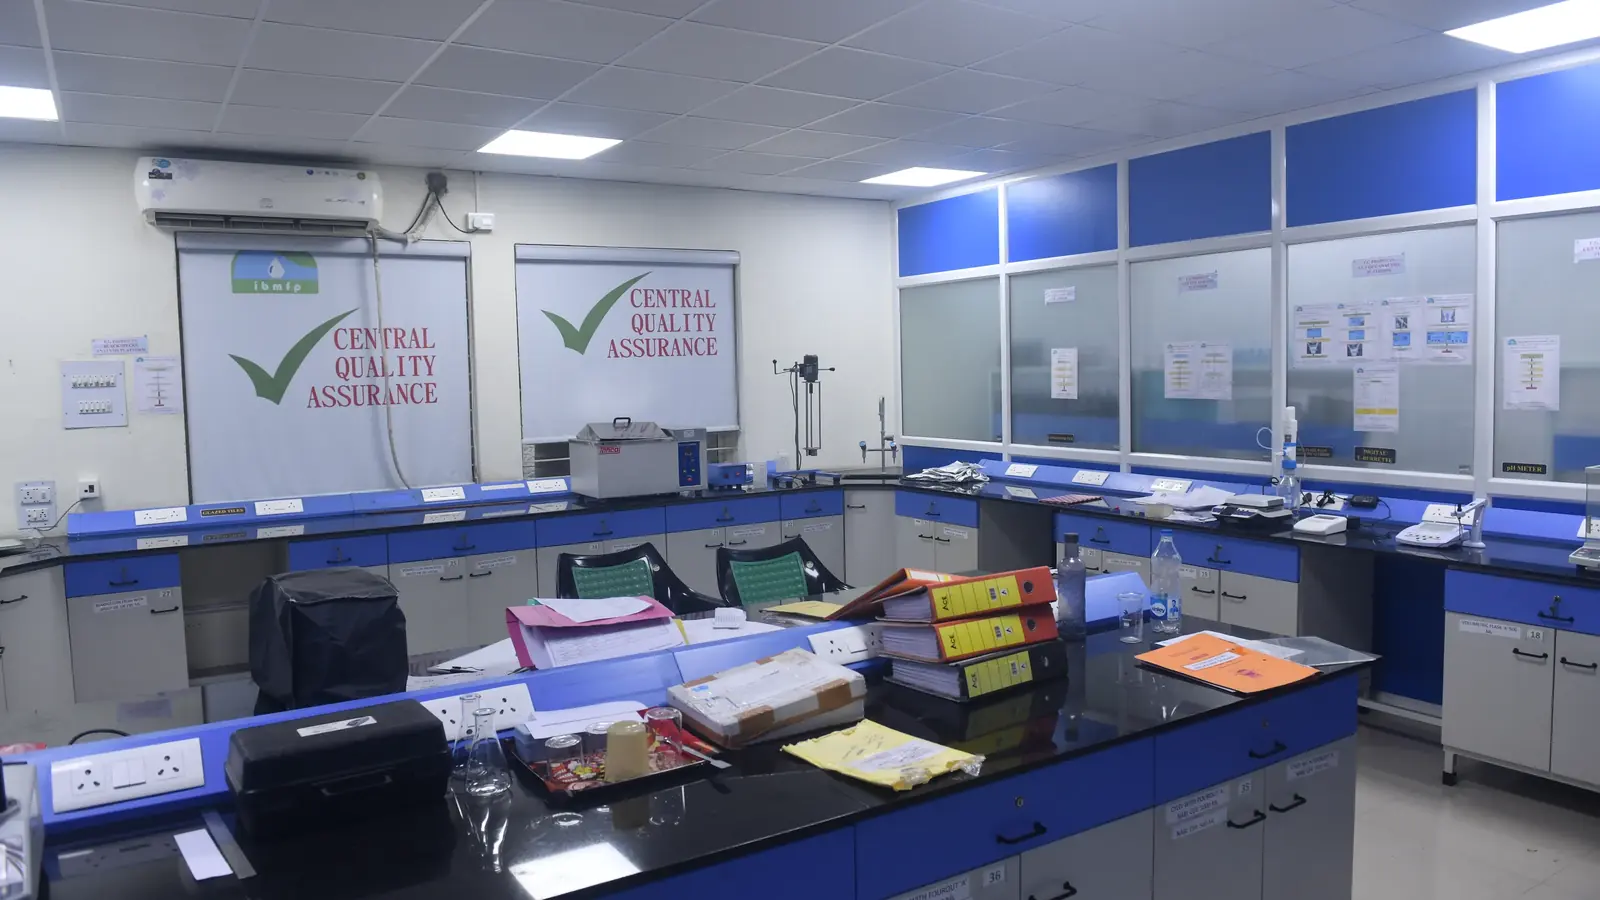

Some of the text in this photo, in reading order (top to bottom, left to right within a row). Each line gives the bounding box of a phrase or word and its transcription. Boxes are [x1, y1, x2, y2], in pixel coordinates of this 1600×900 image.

[630, 288, 717, 309] CENTRAL
[631, 313, 717, 336] QUALITY
[333, 327, 436, 351] CENTRAL
[607, 337, 718, 359] ASSURANCE
[335, 355, 436, 381] QUALITY
[306, 382, 438, 409] ASSURANCE
[1531, 631, 1541, 639] 18
[989, 871, 1001, 882] 36
